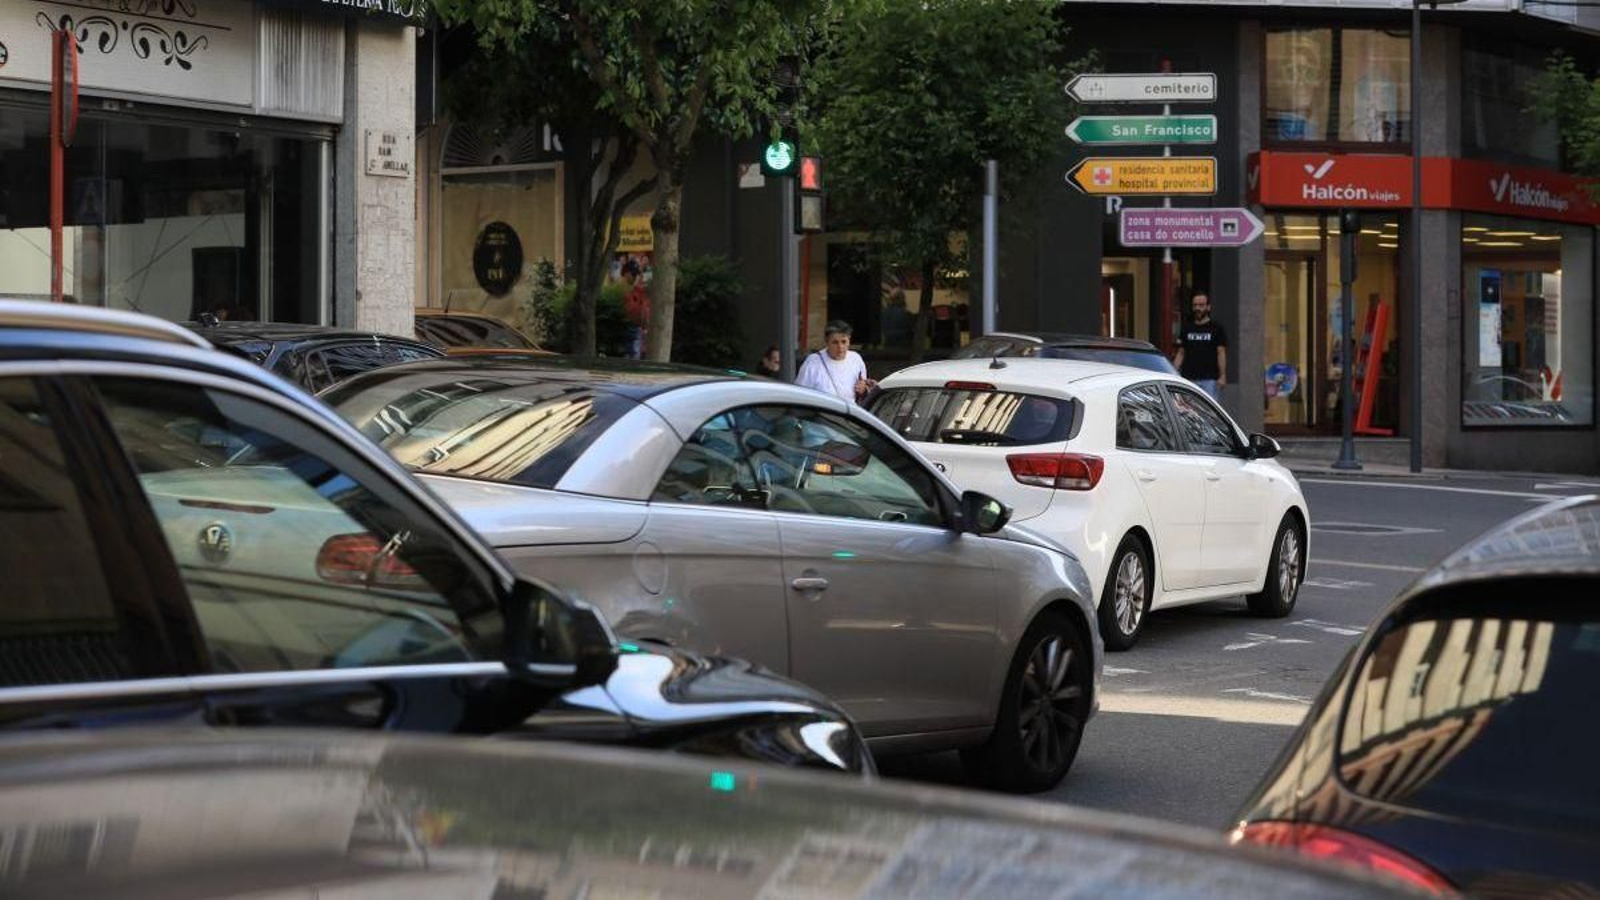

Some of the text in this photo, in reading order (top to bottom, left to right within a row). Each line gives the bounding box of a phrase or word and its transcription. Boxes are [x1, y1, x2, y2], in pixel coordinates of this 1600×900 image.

[1144, 83, 1209, 94] cemiterio
[1111, 124, 1211, 136] San Francisco
[1119, 164, 1209, 174] residencia sanitaria
[1119, 178, 1209, 190] hospital provincial
[1302, 184, 1400, 203] Halcón viajes
[1127, 215, 1214, 226] zona monumental
[1127, 229, 1214, 240] casa do concello
